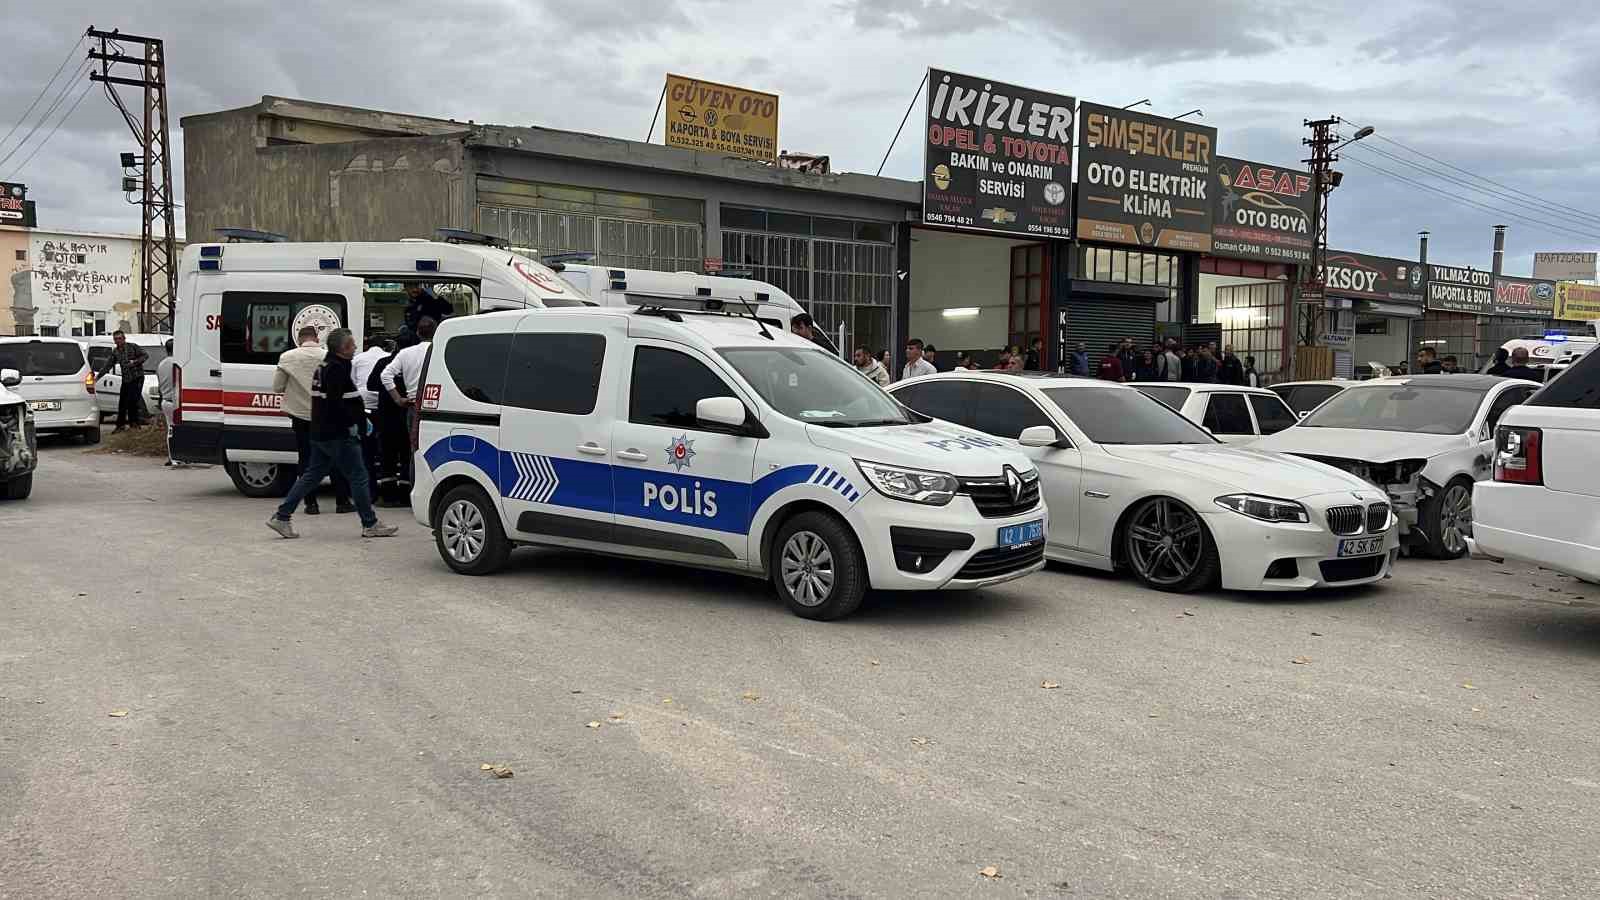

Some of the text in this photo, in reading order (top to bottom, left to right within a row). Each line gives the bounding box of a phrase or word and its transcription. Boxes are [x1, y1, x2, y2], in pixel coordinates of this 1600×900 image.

[671, 80, 774, 118] GÜVEN OTO
[931, 75, 1073, 144] İKİZLER
[670, 120, 709, 139] KAPORTA
[711, 128, 717, 139] &
[720, 129, 740, 143] BOYA
[929, 124, 1070, 165] OPEL & TOYOTA
[1088, 113, 1210, 164] ŞİMŞEKLER
[950, 152, 1053, 180] BAKIM ve ONARIM
[979, 179, 1025, 198] SERVİSİ
[1087, 162, 1207, 200] OTO ELEKTRİK
[1232, 164, 1312, 197] ASAF
[1123, 193, 1172, 219] KLİMA
[965, 217, 973, 225] 21
[1236, 208, 1307, 234] OTO BOYA
[55, 252, 77, 264] OTO
[1214, 241, 1238, 251] Osman
[1434, 266, 1490, 285] YILMAZ OTO
[1431, 284, 1466, 302] KAPORTA
[1466, 289, 1472, 303] &
[1473, 289, 1492, 305] BOYA
[426, 386, 439, 399] 112
[643, 481, 718, 517] POLİS
[1344, 540, 1355, 554] 42
